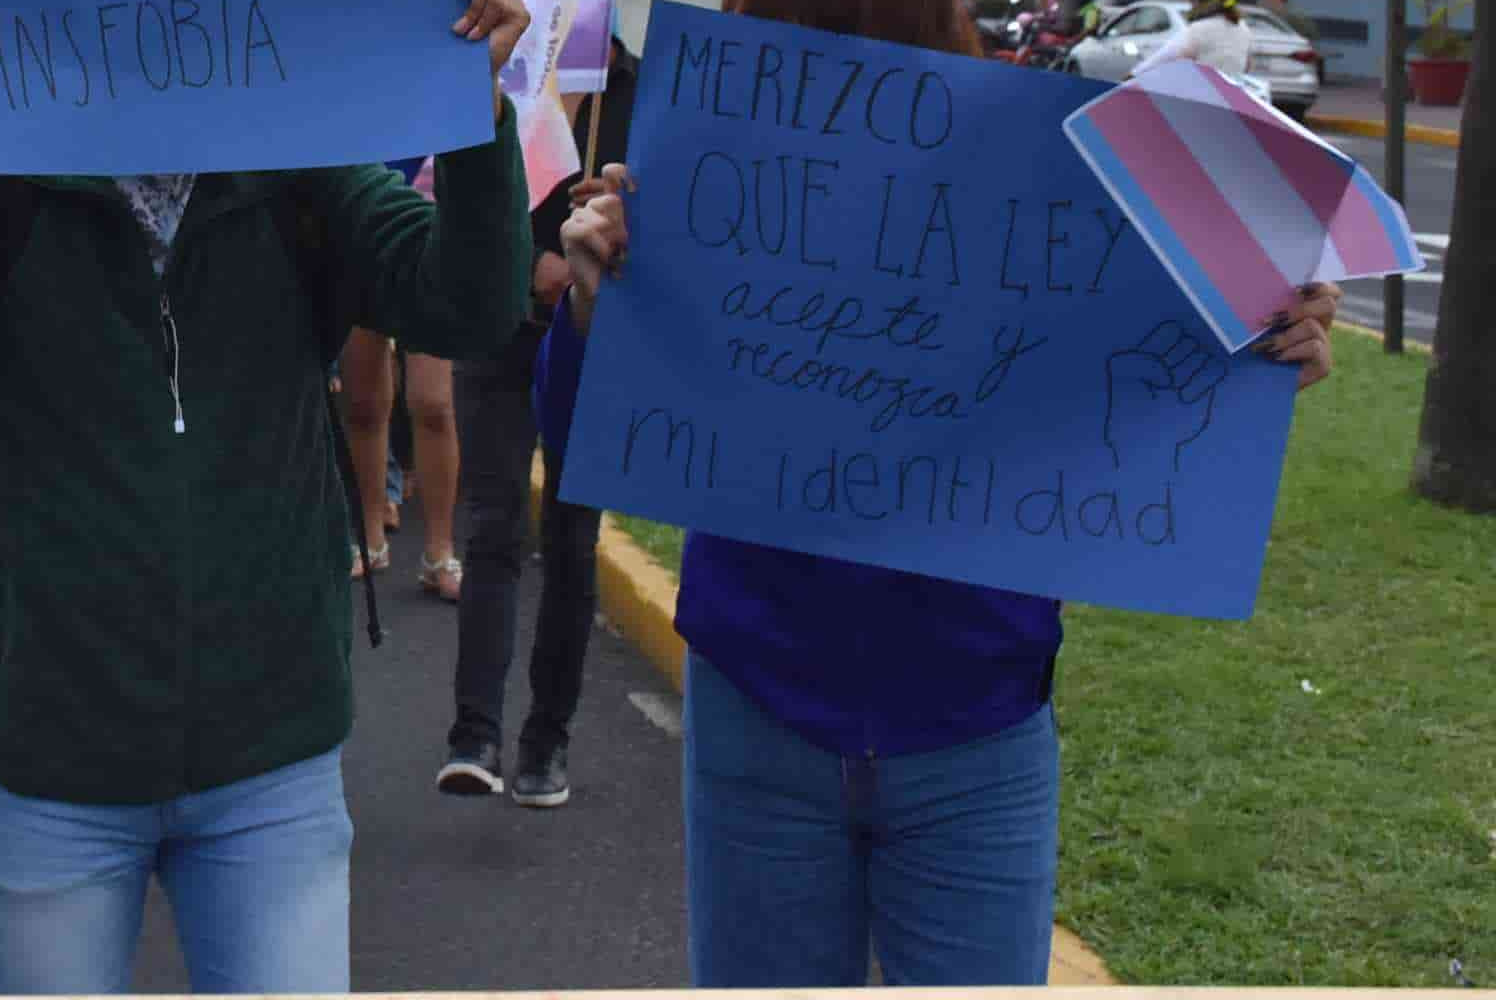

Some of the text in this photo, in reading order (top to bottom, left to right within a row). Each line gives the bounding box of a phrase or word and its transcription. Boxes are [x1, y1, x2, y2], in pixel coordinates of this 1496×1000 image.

[672, 33, 954, 149] MEREZCO
[688, 152, 1130, 299] QUE LA LEY
[722, 282, 1048, 402] acepte y
[726, 335, 966, 433] reconozca
[776, 448, 1177, 546] identidad
